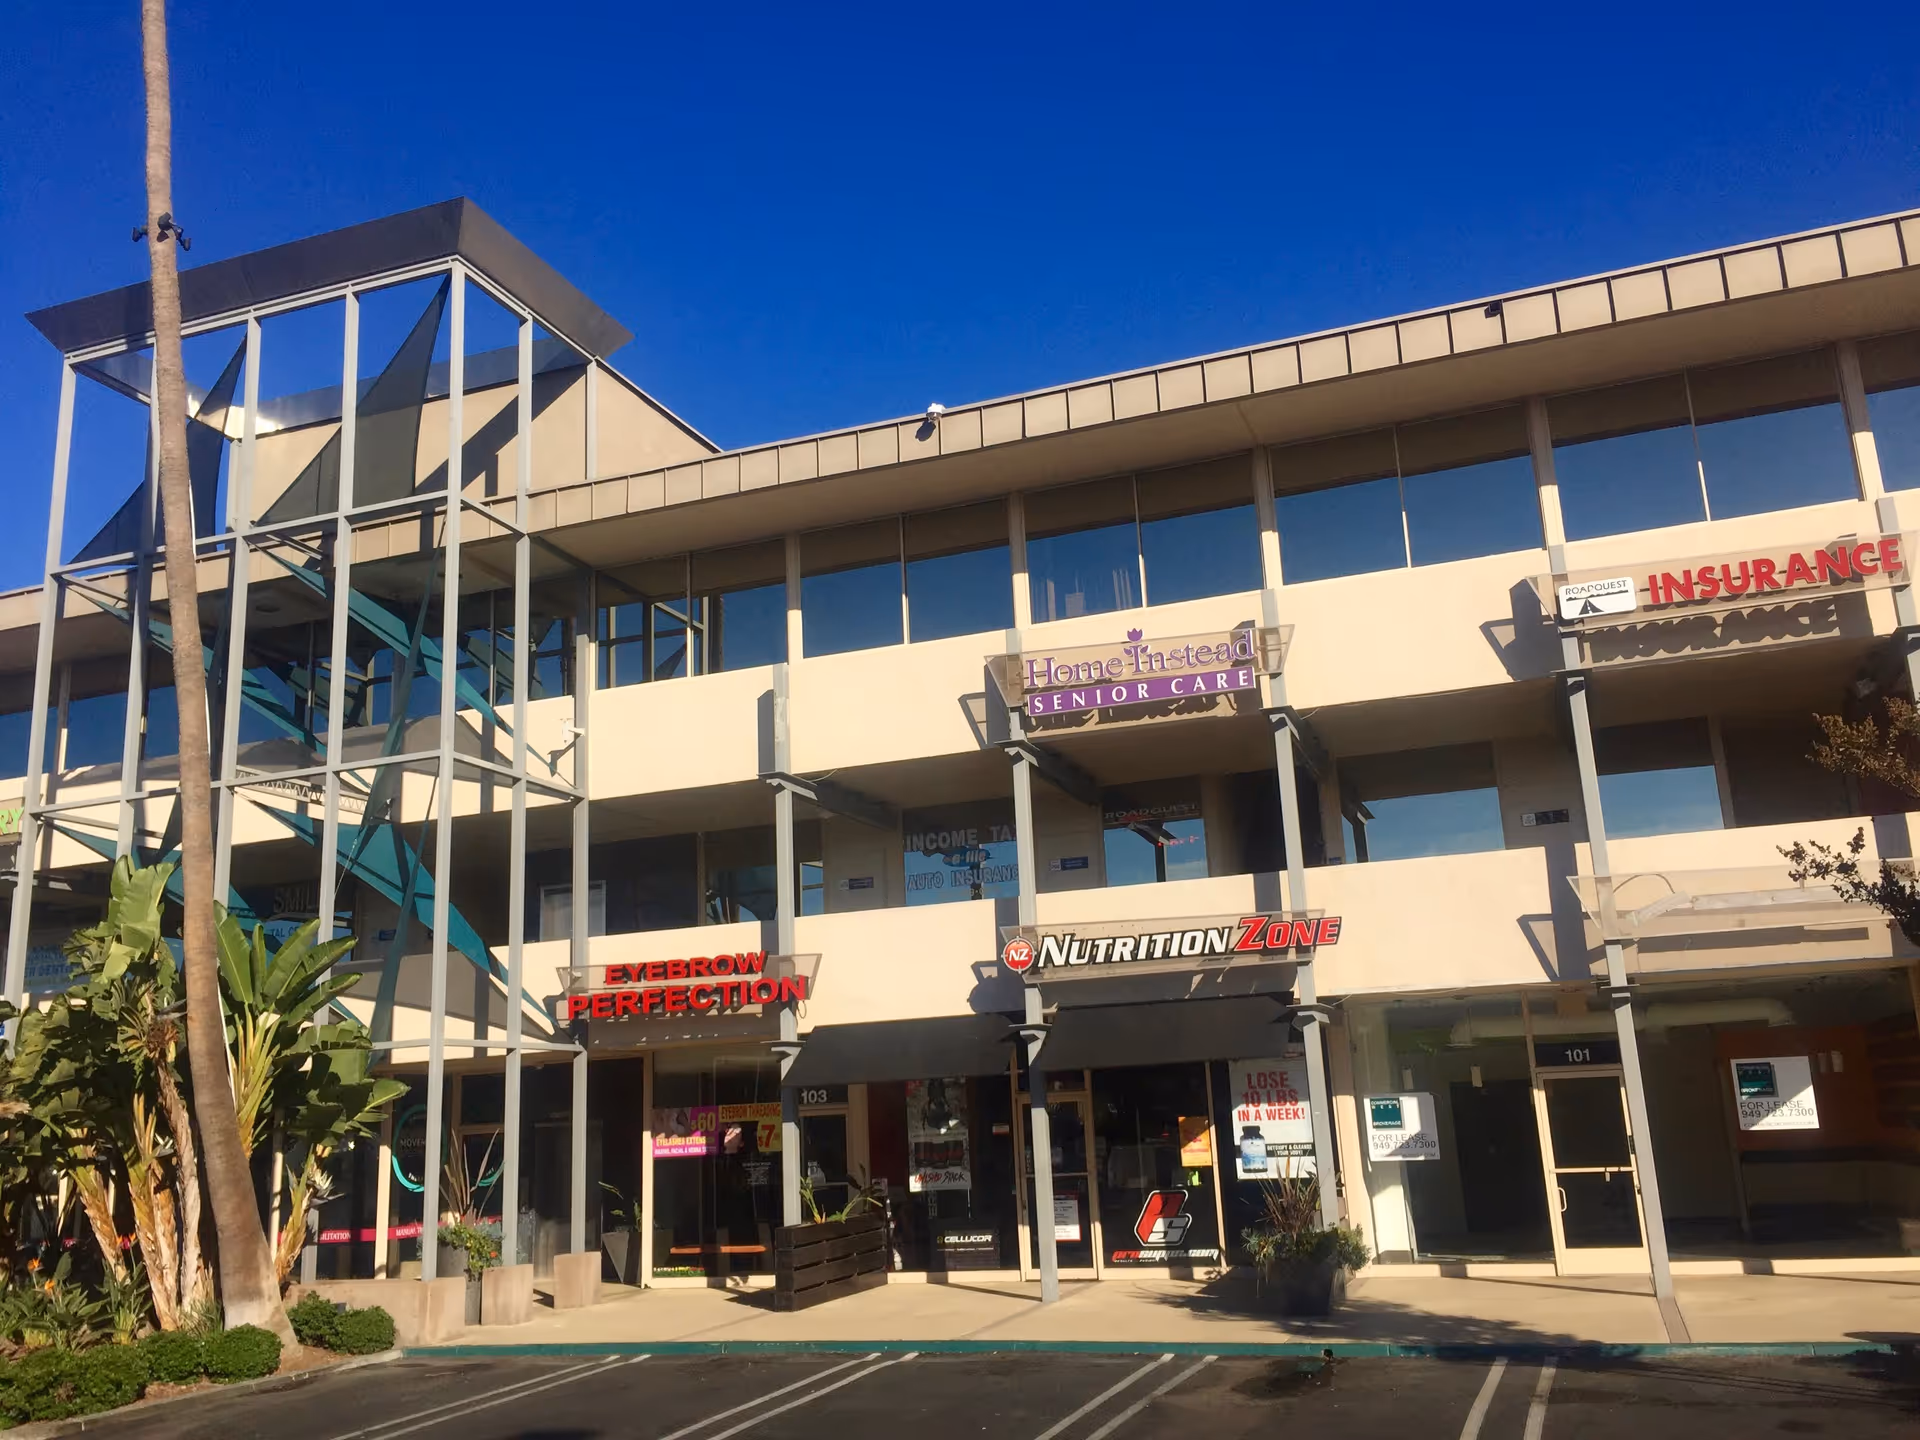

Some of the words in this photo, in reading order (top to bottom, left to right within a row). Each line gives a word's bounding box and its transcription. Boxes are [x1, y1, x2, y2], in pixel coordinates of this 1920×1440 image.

[1648, 538, 1903, 605] INSURANCE
[1025, 656, 1124, 688] Home
[1128, 629, 1257, 675] Instead
[1033, 685, 1149, 712] SENIOR
[1171, 669, 1250, 695] CARE
[905, 828, 978, 851] INCOME
[990, 824, 1018, 842] TA
[907, 871, 945, 891] AUTO
[950, 863, 1018, 887] INSURANC
[1008, 949, 1029, 962] NZ
[604, 950, 767, 986] EYEBROW
[568, 975, 810, 1021] PERFECTION
[1564, 1048, 1591, 1062] 101
[1246, 1071, 1289, 1090] LOSE
[801, 1089, 828, 1104] 103
[1242, 1089, 1261, 1108] 10
[1267, 1089, 1299, 1107] LBS
[1740, 1101, 1765, 1110] FOR
[1767, 1100, 1804, 1109] LEASE
[1741, 1107, 1815, 1118] 949.723.7300
[1237, 1110, 1250, 1122] IN
[1254, 1109, 1262, 1121] A
[1265, 1107, 1306, 1121] WEEK!
[1372, 1134, 1394, 1142] FOR
[1395, 1133, 1427, 1142] LEASE
[1373, 1140, 1437, 1150] 949.723.7300
[320, 1232, 351, 1241] ILITATION
[944, 1234, 993, 1243] CELLUCOR
